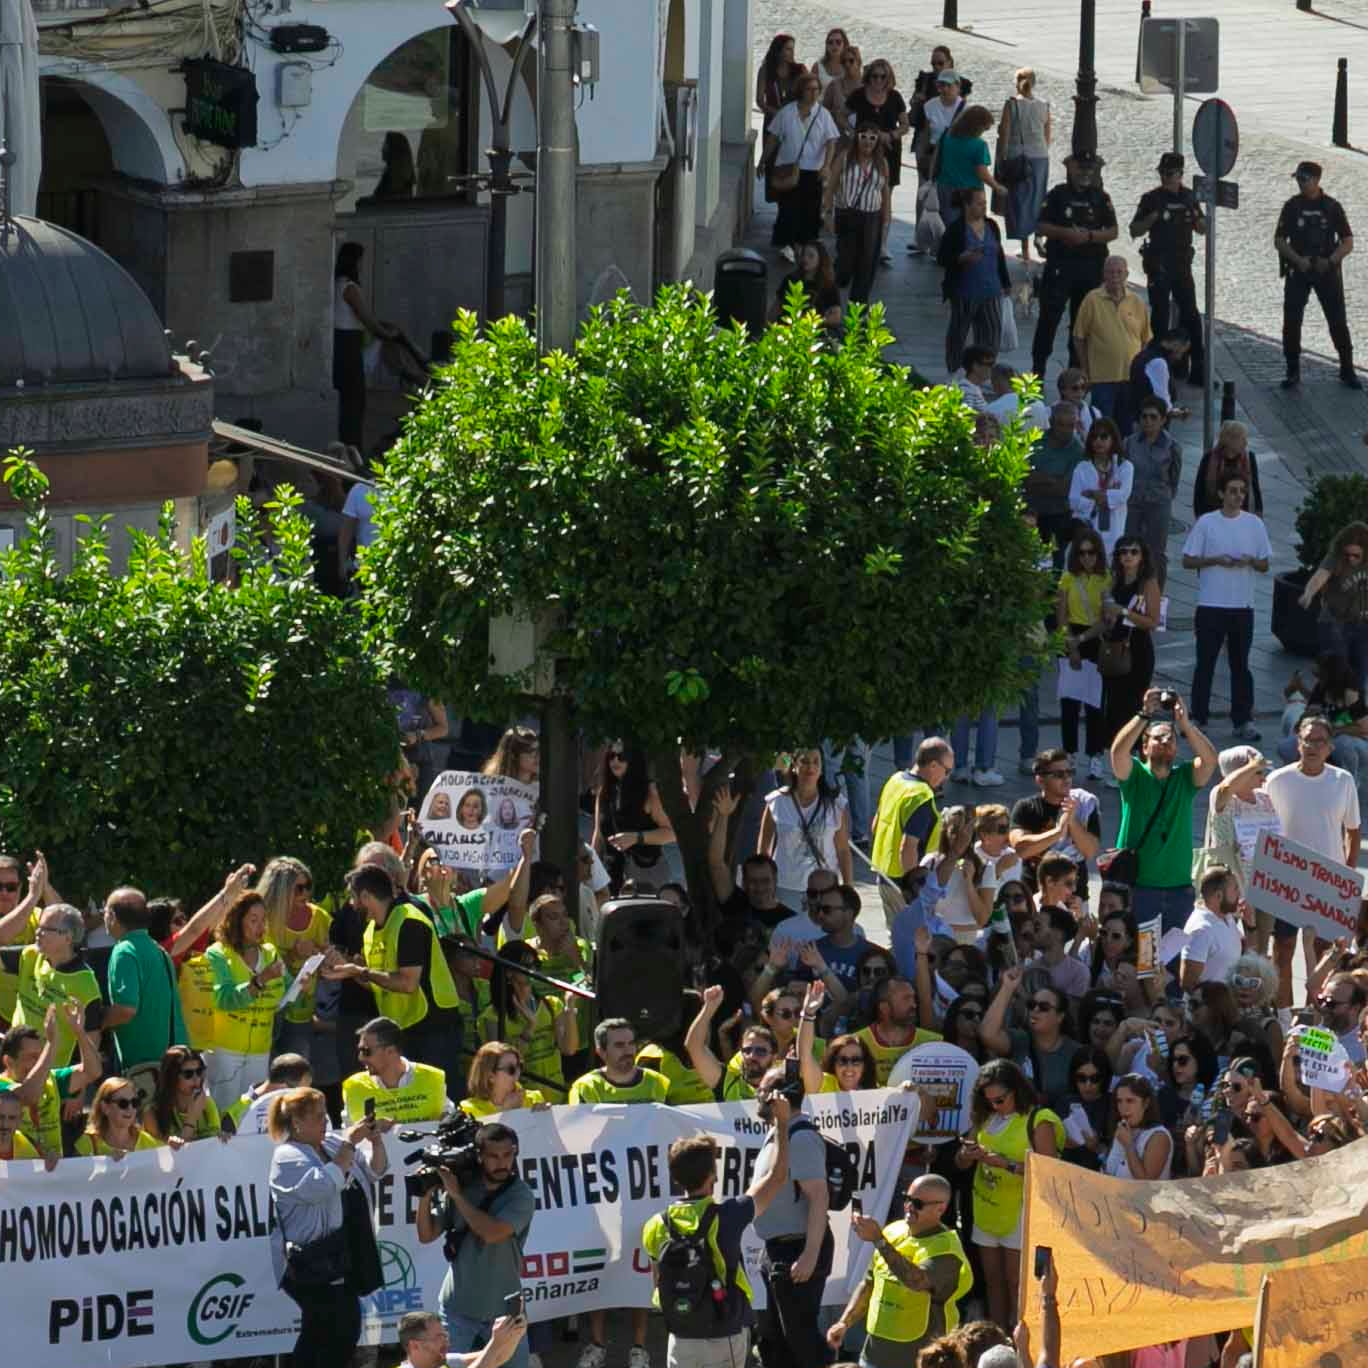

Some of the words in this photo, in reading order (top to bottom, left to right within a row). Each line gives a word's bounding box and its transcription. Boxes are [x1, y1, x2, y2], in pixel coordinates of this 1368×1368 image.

[0, 1178, 207, 1263] HOMOLOGACIÓN
[627, 1146, 661, 1201] DE
[522, 1275, 599, 1306] eñanza
[201, 1294, 254, 1323] CSIF
